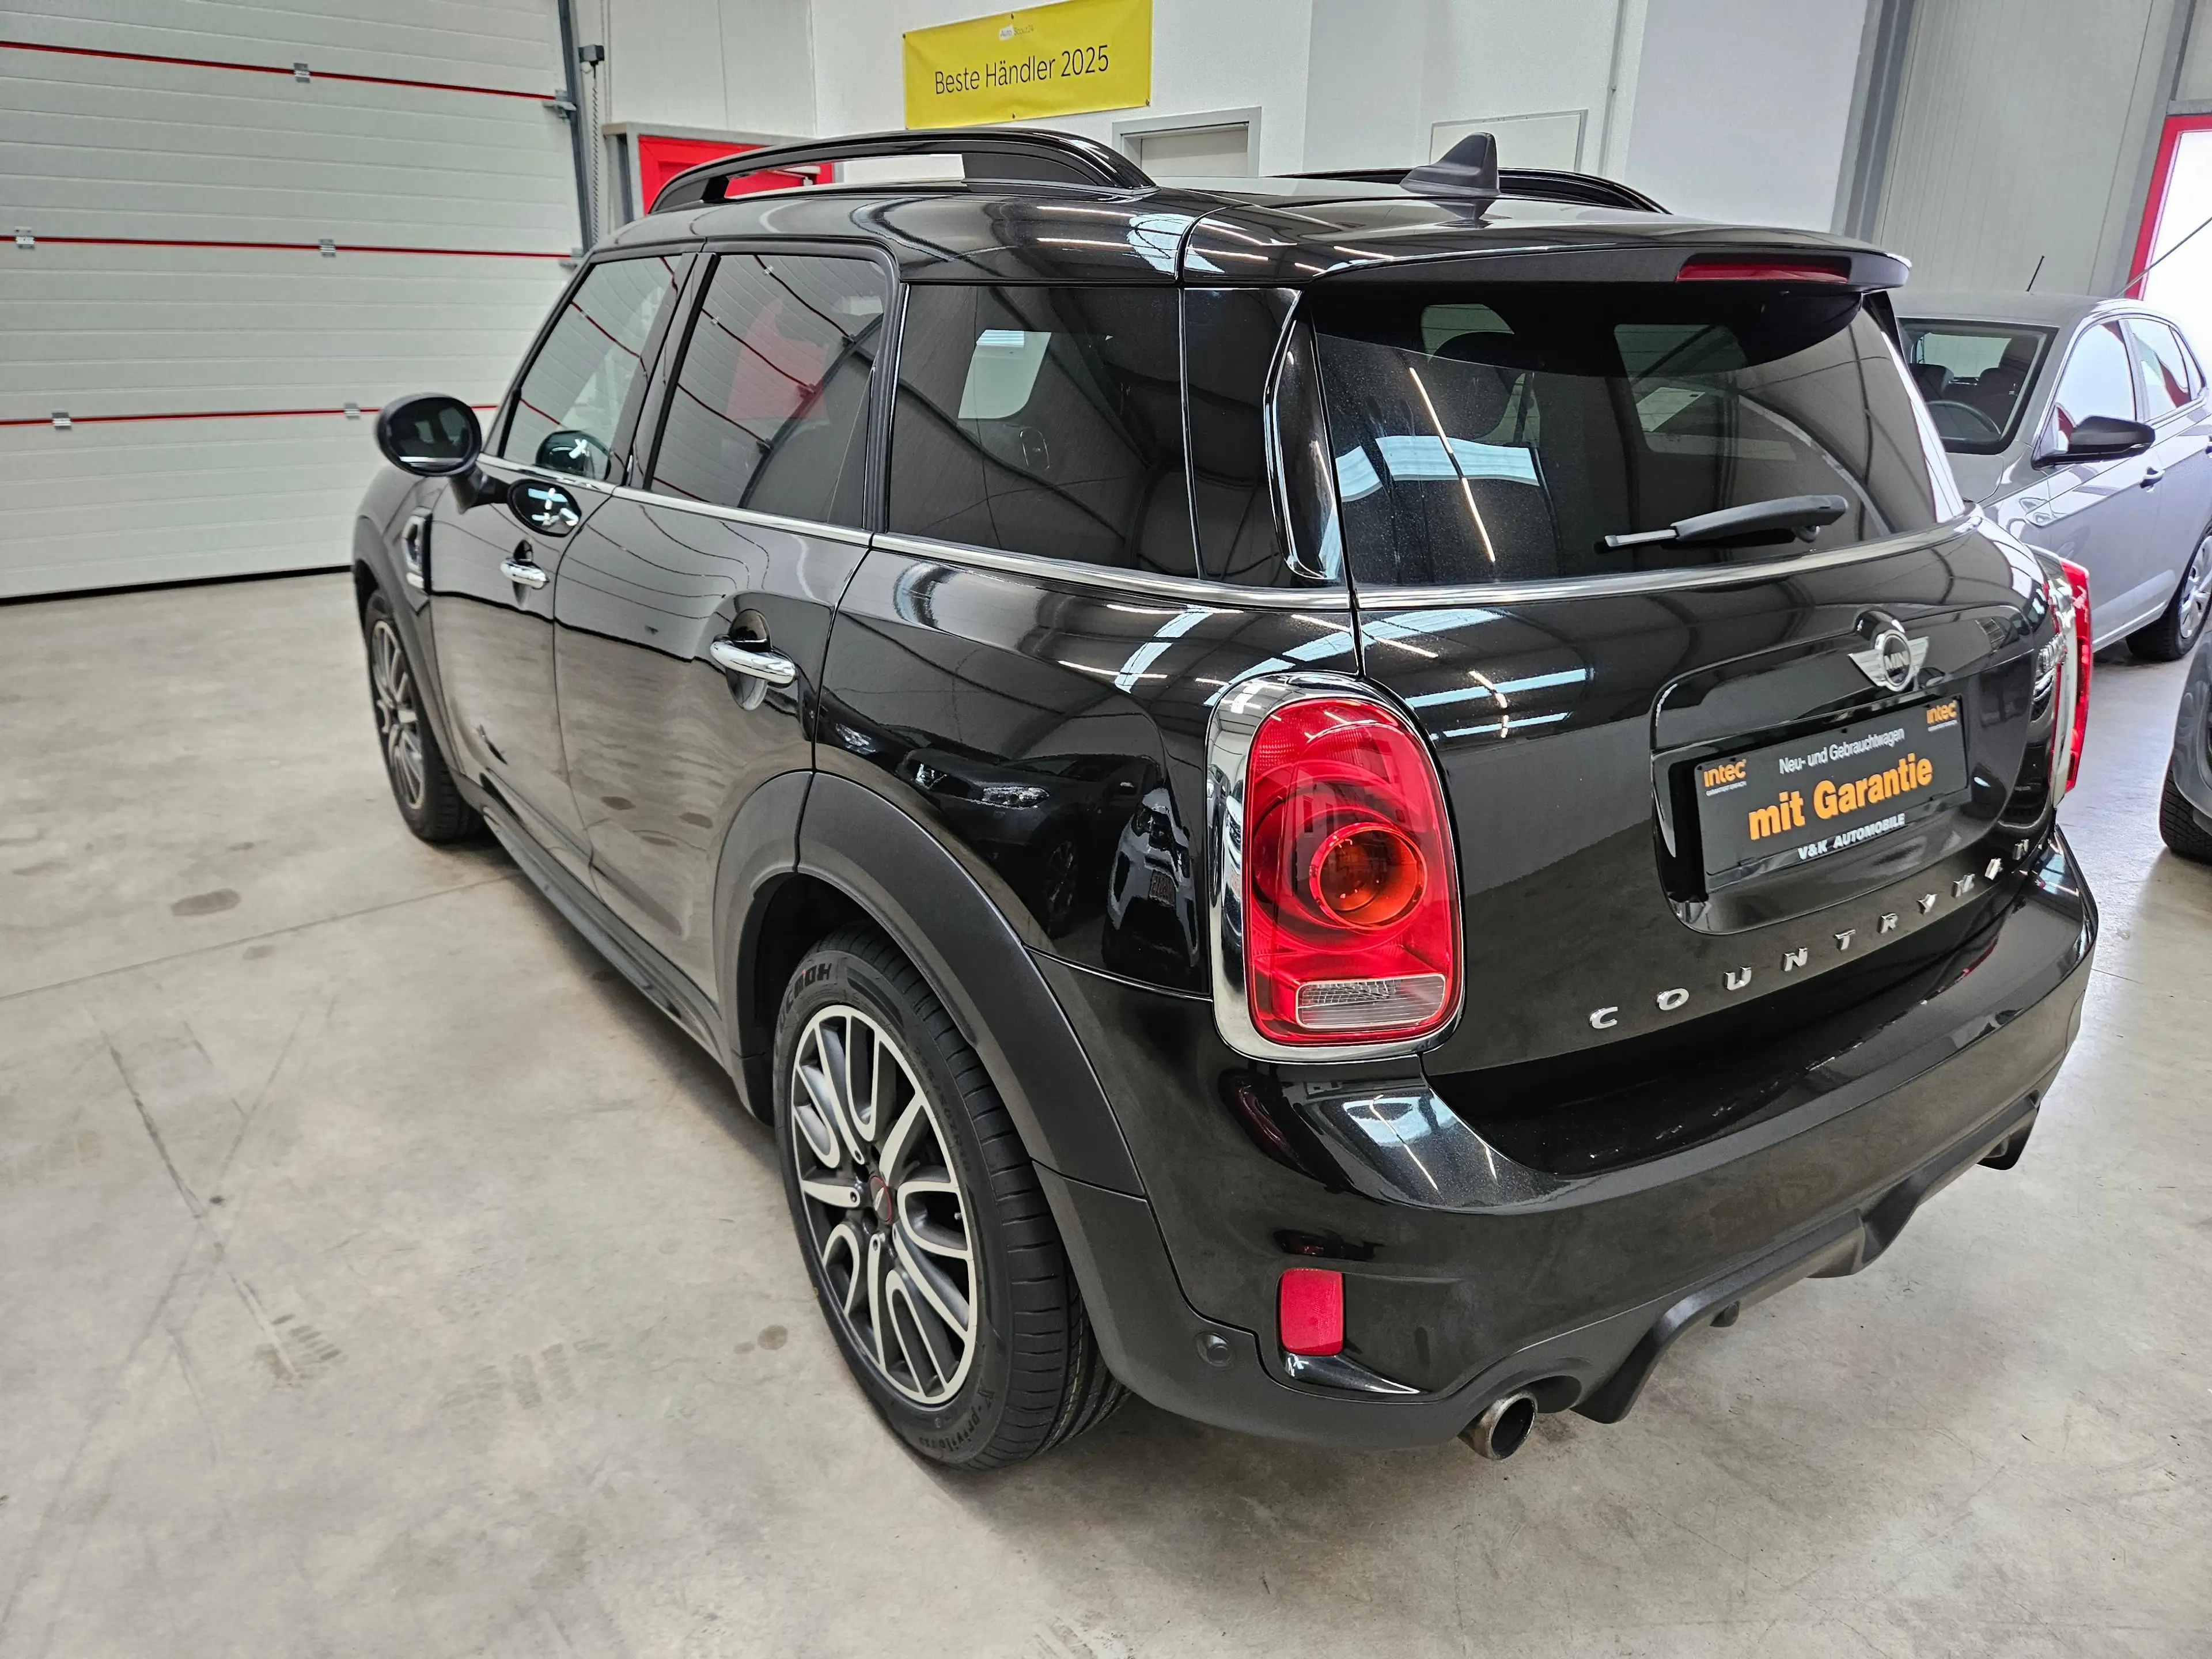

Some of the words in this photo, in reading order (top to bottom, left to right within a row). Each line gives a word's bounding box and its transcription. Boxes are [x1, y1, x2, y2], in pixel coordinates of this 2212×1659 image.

[935, 67, 980, 94] Beste
[986, 56, 1056, 88] Händler
[1061, 44, 1109, 77] 2025
[1926, 702, 1957, 724] intec
[1703, 761, 1747, 787] intec
[1779, 755, 1806, 775] Neu-
[1807, 746, 1828, 768] und
[1829, 728, 1905, 762] Gebrauchtwagen
[1748, 789, 1806, 841] mit
[1813, 752, 1933, 820] Garantie
[1798, 838, 1828, 861] V&K
[1832, 812, 1906, 849] AUTOMOBILE
